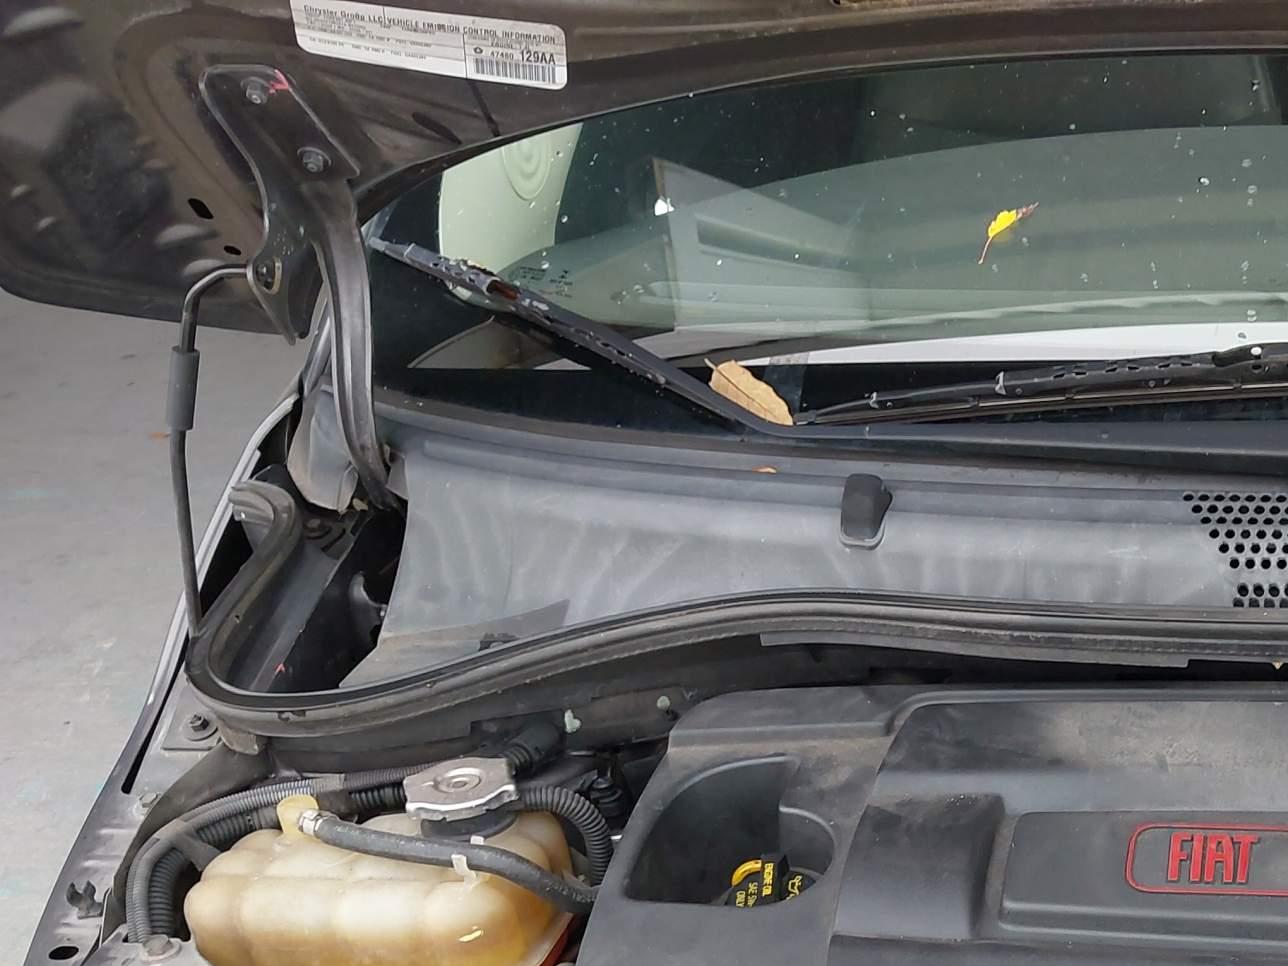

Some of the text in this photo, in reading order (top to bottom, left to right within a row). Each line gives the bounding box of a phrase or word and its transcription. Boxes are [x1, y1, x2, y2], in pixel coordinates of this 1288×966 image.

[463, 26, 497, 37] CONTROL
[501, 31, 556, 45] INFORMATION
[520, 49, 556, 65] 129AA
[1167, 831, 1259, 884] FIAT
